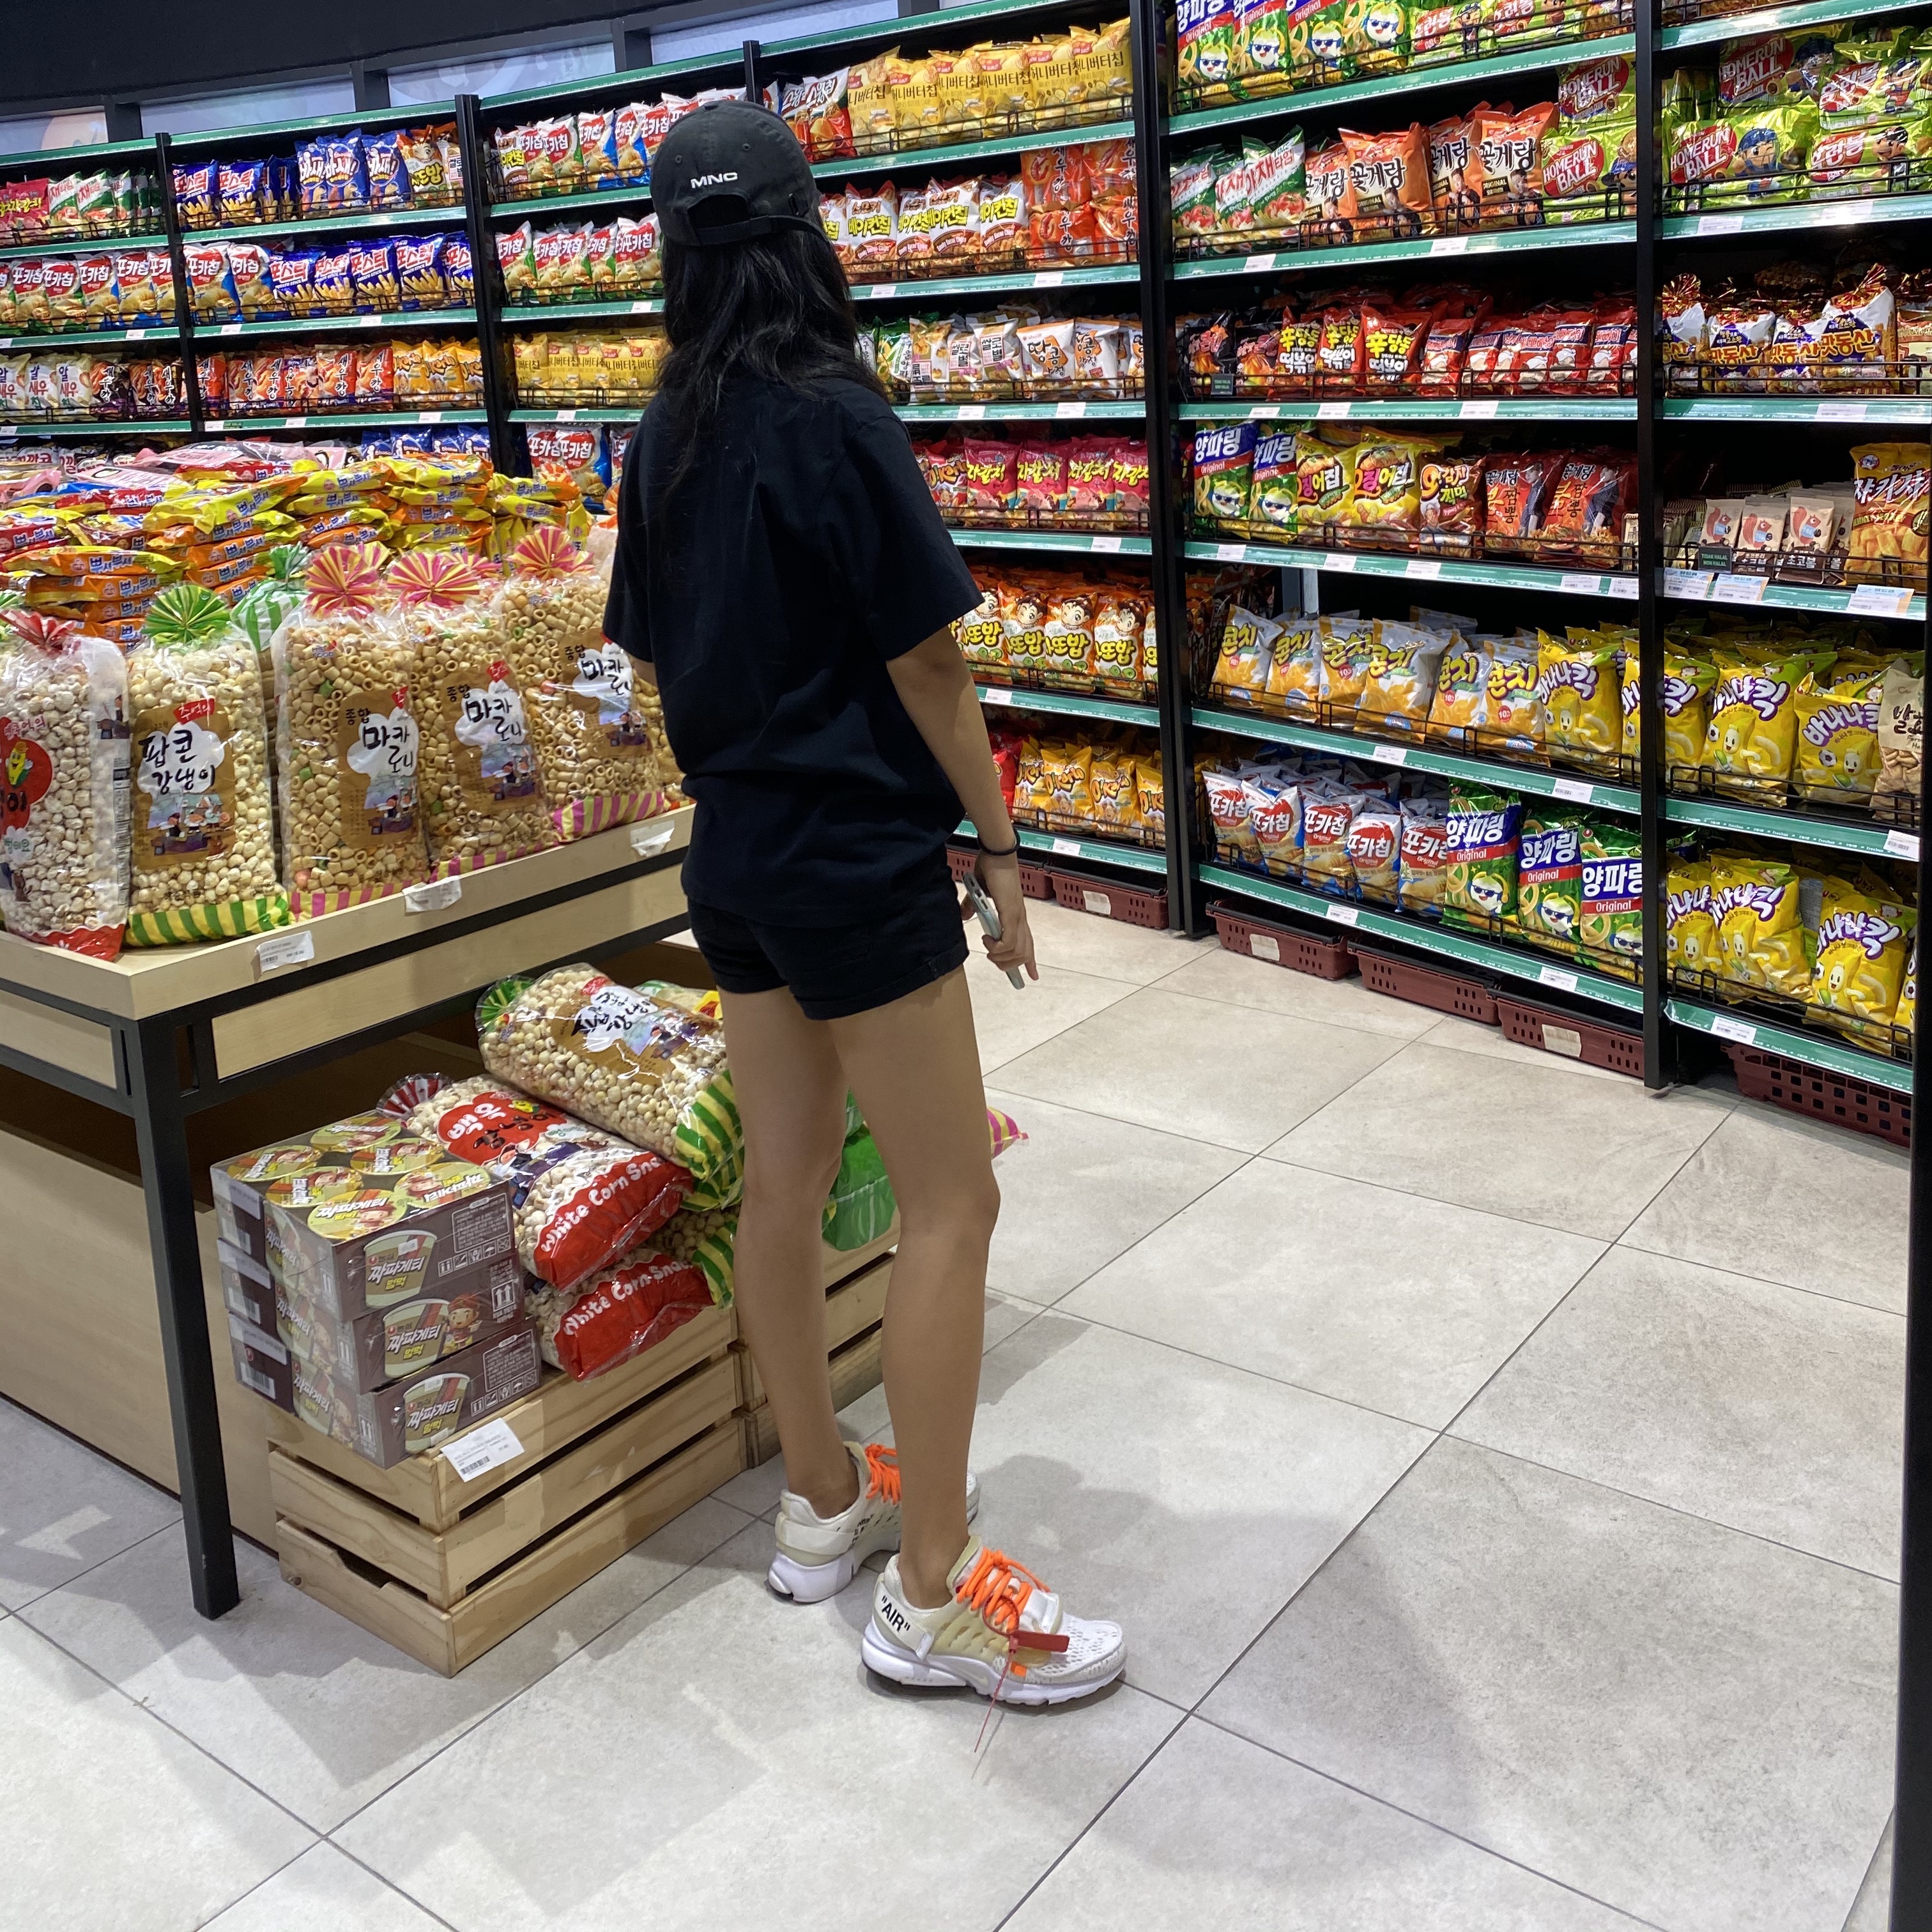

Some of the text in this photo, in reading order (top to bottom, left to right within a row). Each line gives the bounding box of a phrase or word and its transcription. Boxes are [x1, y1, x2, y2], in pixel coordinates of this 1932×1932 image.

[1295, 2, 1321, 22] Original
[1185, 21, 1211, 43] Original
[1719, 37, 1784, 82] HOMERUN
[1558, 56, 1621, 100] HOMERUN
[1735, 56, 1782, 92] BALL
[848, 84, 885, 105] 니버터칩
[1576, 74, 1620, 109] BALL
[1479, 137, 1537, 173] 꽃게랑
[1669, 125, 1731, 171] HOMERUN
[1053, 146, 1067, 193] 새우깡
[1349, 157, 1406, 194] 꽃게랑
[1543, 141, 1597, 185] HOMERUN
[1556, 158, 1597, 192] BALL
[1684, 144, 1728, 181] BALL
[847, 215, 893, 237] 베이컨칩
[928, 205, 969, 229] 베이컨칩
[397, 242, 434, 269] 포스틱
[624, 232, 653, 254] 포카칩
[150, 256, 172, 276] 포카
[188, 257, 221, 277] 포카칩
[351, 249, 390, 275] 포스틱
[447, 245, 472, 270] 포스
[1027, 339, 1061, 367] 땅콩
[1662, 342, 1690, 362] 동산
[1821, 330, 1875, 357] 맛동산
[335, 352, 349, 397] 새우깡
[560, 441, 593, 459] 포카칩
[1195, 427, 1242, 463] 양파링
[967, 463, 1006, 488] 자갈치
[1017, 460, 1061, 486] 자갈치
[1200, 461, 1225, 475] Original
[1485, 468, 1519, 487] 꽃게랑
[1222, 622, 1257, 657] 콘치
[1274, 629, 1314, 667] 콘치
[564, 645, 586, 662] 종합
[446, 684, 471, 703] 종합
[1487, 660, 1538, 700] 콘치
[345, 708, 371, 726] 종합
[464, 697, 512, 723] 마카
[362, 724, 410, 750] 마카
[493, 716, 523, 742] 로니
[138, 730, 197, 767] 팝콘
[387, 746, 414, 774] 로니
[151, 765, 217, 796] 강냉이
[1210, 794, 1247, 819] 포카칩
[1251, 811, 1291, 834] 포카칩
[1303, 809, 1347, 836] 포카칩
[1446, 813, 1505, 848] 양파링
[1347, 834, 1390, 859] 포카칩
[1456, 849, 1487, 862] Original
[1520, 829, 1579, 870] 양파링
[1528, 869, 1560, 883] Original
[1595, 900, 1632, 913] Original
[540, 1204, 590, 1254] White
[588, 1175, 629, 1207] Corn
[625, 1156, 663, 1182] Sna
[367, 1256, 426, 1285] 짜파게티
[384, 1275, 408, 1291] 범벅
[563, 1260, 693, 1337] White Corn Snac
[386, 1324, 442, 1354] 짜파게티
[402, 1344, 425, 1360] 범벅
[406, 1397, 461, 1430] 짜파게티
[882, 1595, 911, 1632] "AIR"
